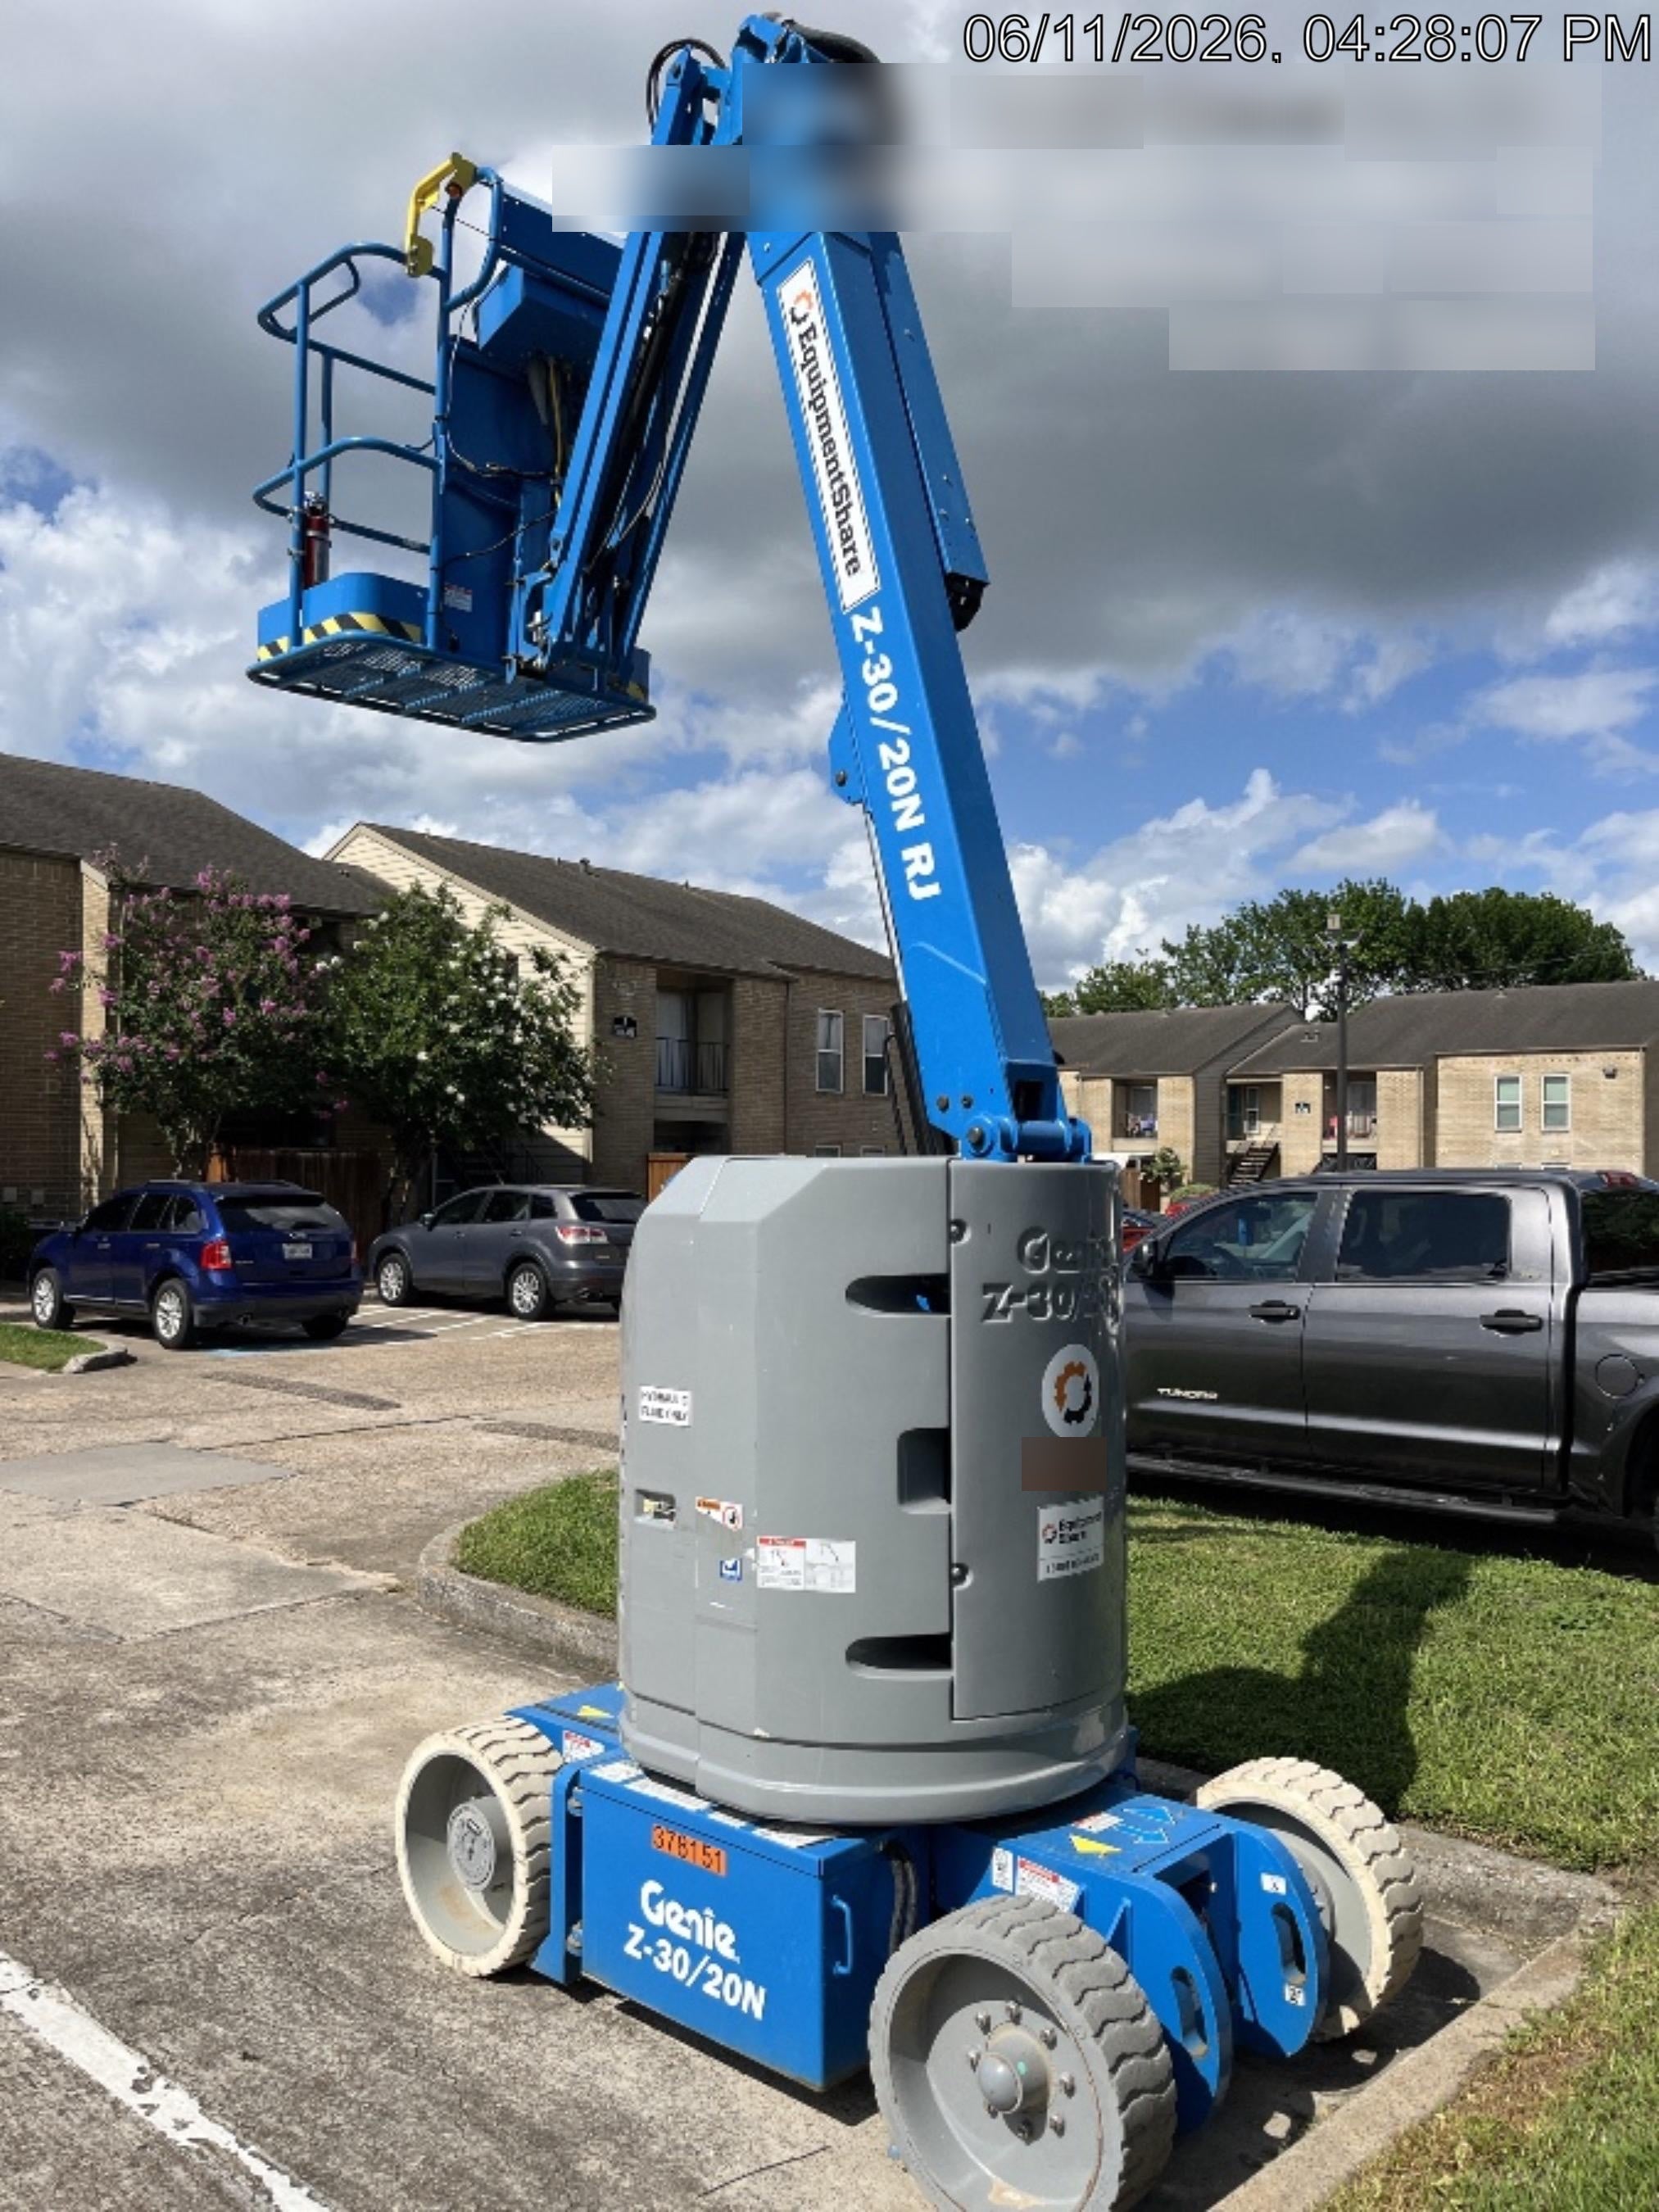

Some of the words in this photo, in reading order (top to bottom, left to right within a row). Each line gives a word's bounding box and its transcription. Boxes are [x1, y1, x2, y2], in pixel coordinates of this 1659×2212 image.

[797, 324, 862, 577] EquipmentShare
[850, 606, 926, 832] Z-30/20N
[901, 841, 942, 900] RJ
[623, 1922, 767, 2020] Z-30/20N
[641, 1879, 739, 1964] Genie
